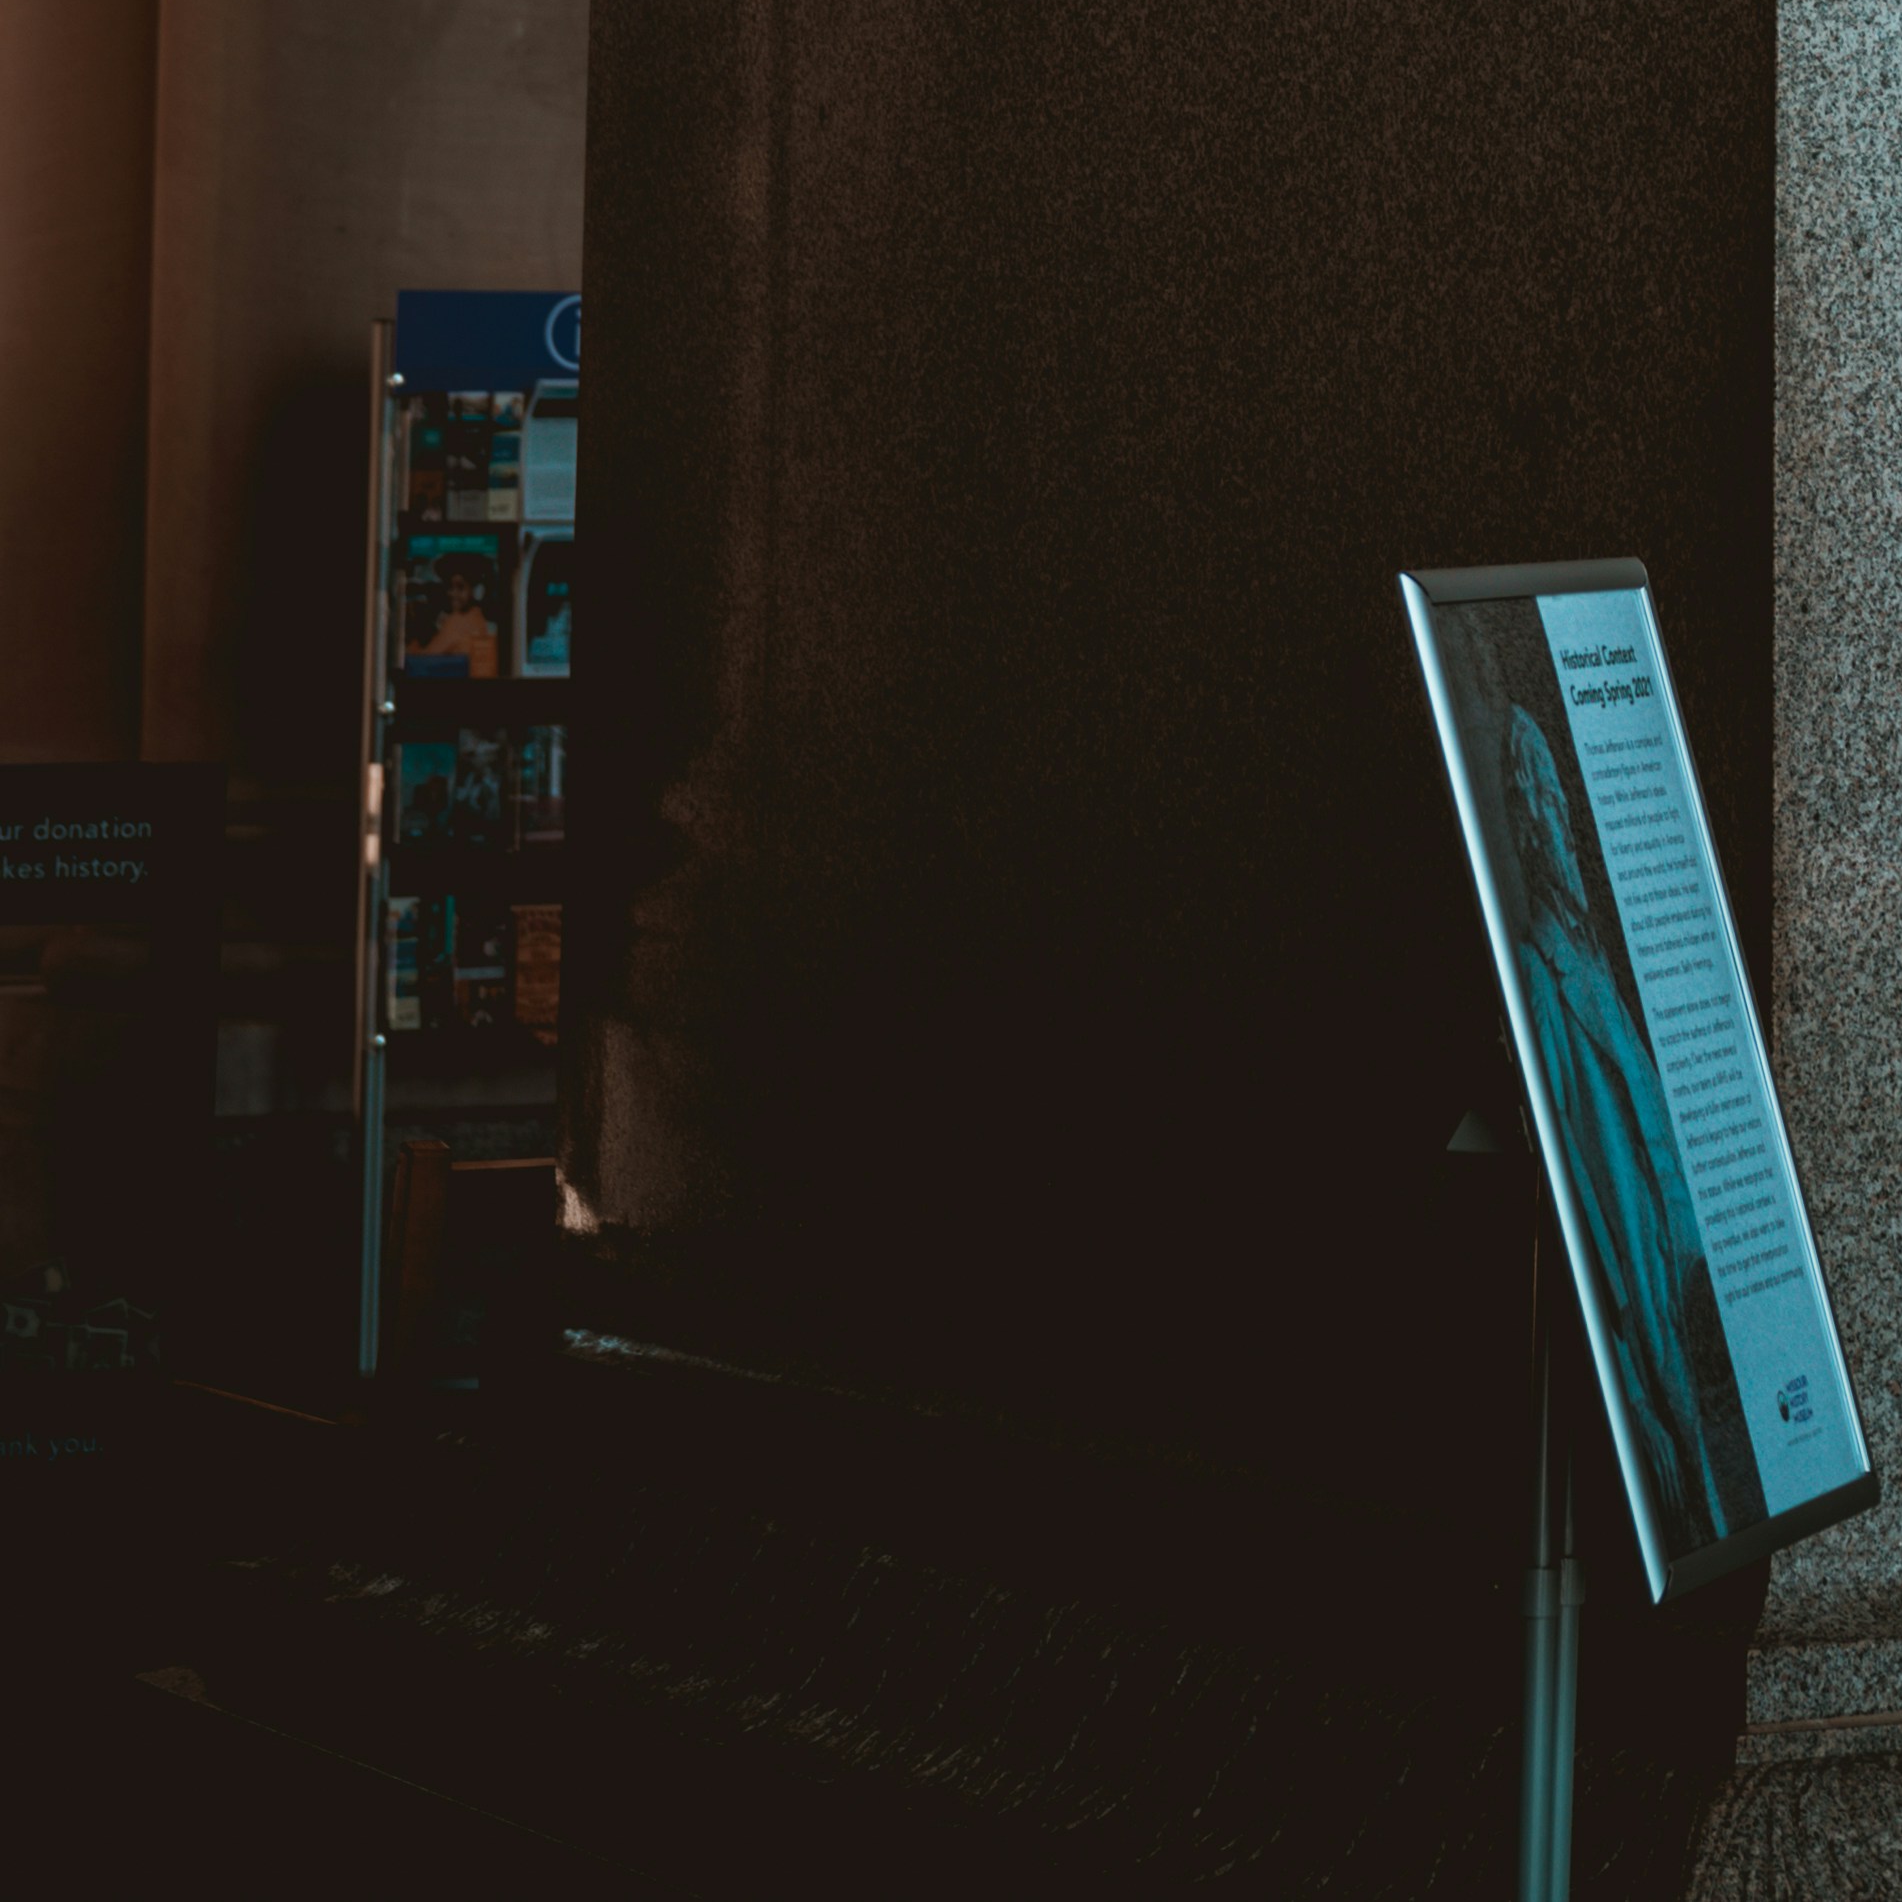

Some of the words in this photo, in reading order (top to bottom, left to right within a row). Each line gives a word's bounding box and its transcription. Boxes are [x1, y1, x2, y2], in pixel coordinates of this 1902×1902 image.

[1560, 645, 1603, 670] Historical
[1601, 644, 1637, 666] Context
[1570, 683, 1606, 709] Coming
[1603, 680, 1635, 707] Spring
[1632, 676, 1653, 698] 2021
[32, 817, 152, 841] donation
[54, 854, 149, 884] history.
